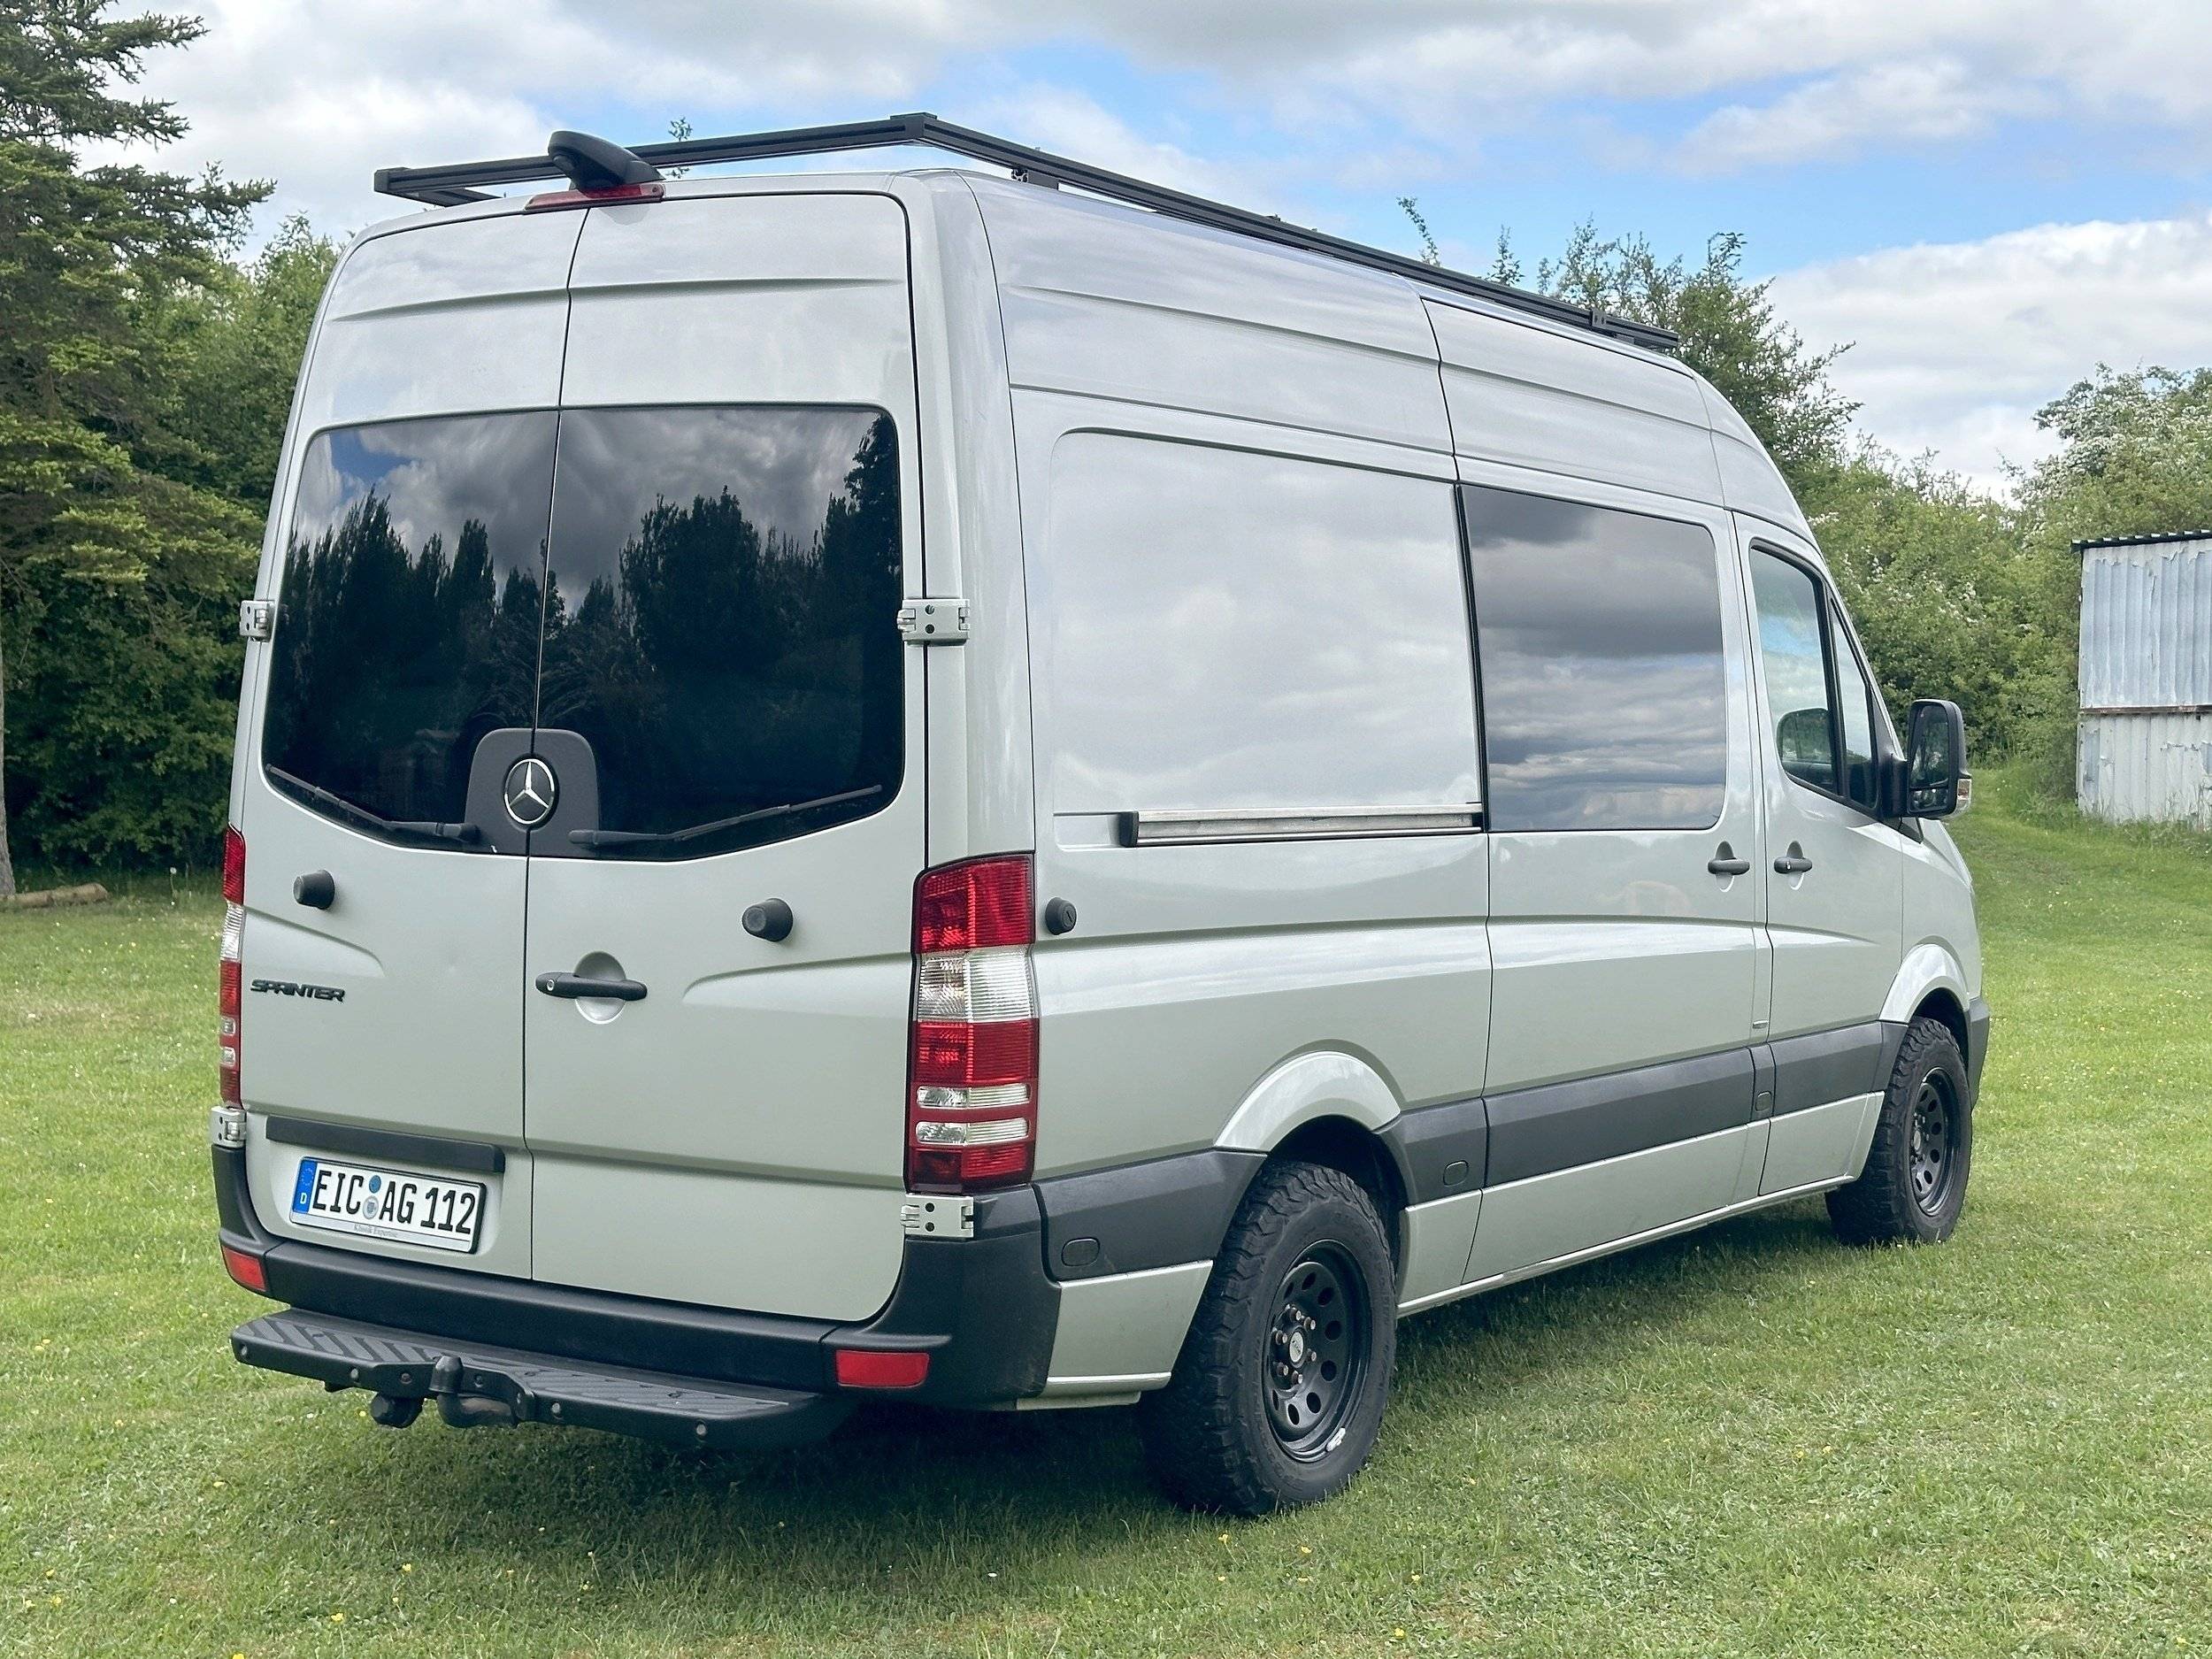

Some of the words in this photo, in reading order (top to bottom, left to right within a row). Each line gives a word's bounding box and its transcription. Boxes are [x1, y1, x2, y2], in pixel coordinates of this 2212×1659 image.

[250, 979, 345, 1002] SPRINTER
[300, 1192, 307, 1204] D
[312, 1170, 365, 1215] EIC
[379, 1180, 418, 1225] AG
[420, 1187, 476, 1235] 112
